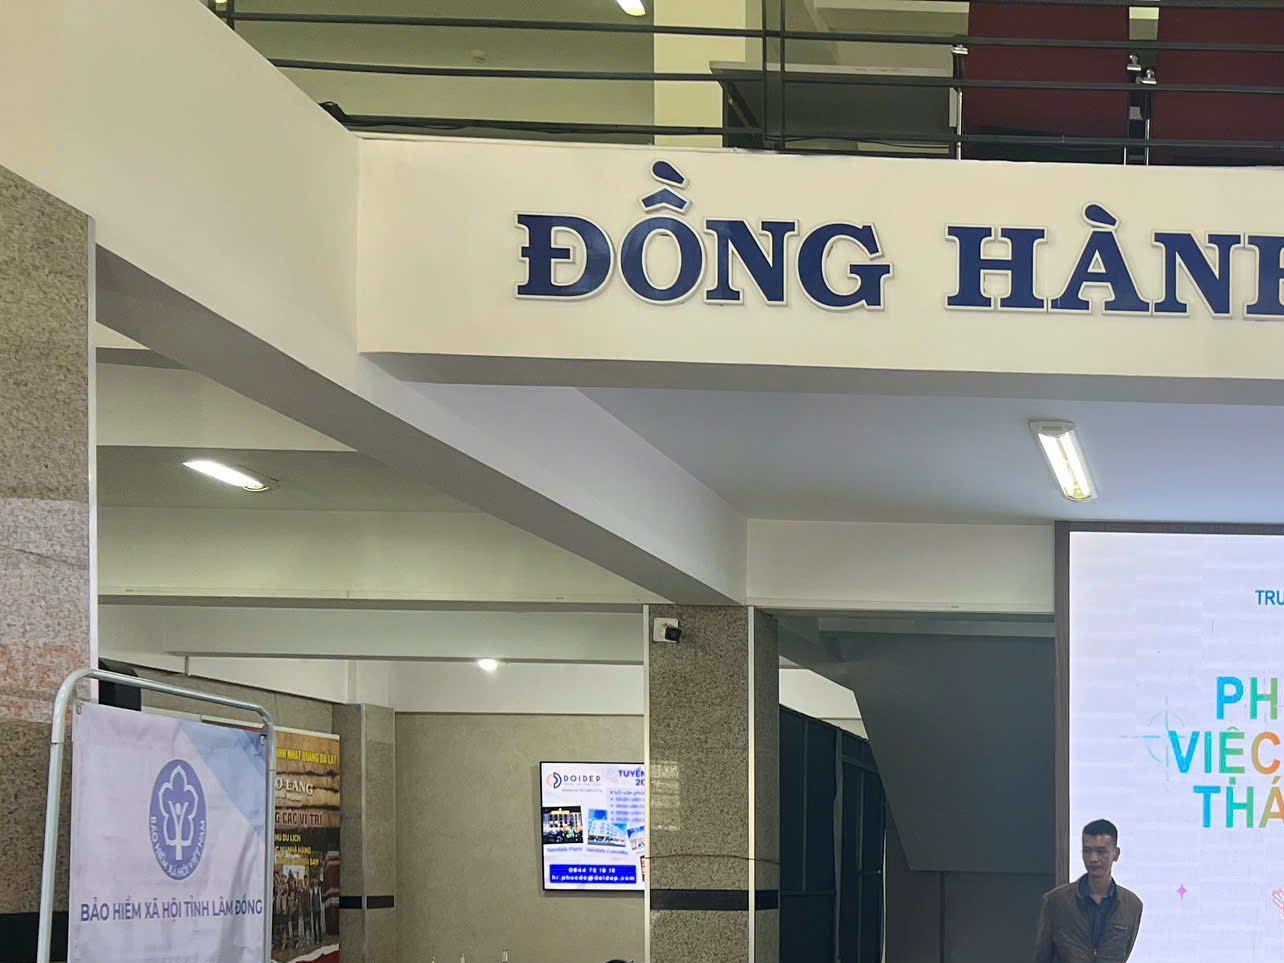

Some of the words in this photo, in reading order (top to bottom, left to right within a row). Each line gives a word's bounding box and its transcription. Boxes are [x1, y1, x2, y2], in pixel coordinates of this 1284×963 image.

[515, 160, 893, 310] ĐỒNG
[1168, 726, 1281, 785] VIỆC
[563, 774, 601, 783] DOIDEP
[80, 897, 110, 922] BẢO
[113, 896, 142, 921] HIỂM
[144, 898, 160, 919] XÃ
[162, 897, 182, 922] HỘI
[183, 895, 209, 918] TỈNH
[213, 896, 233, 917] LÂM
